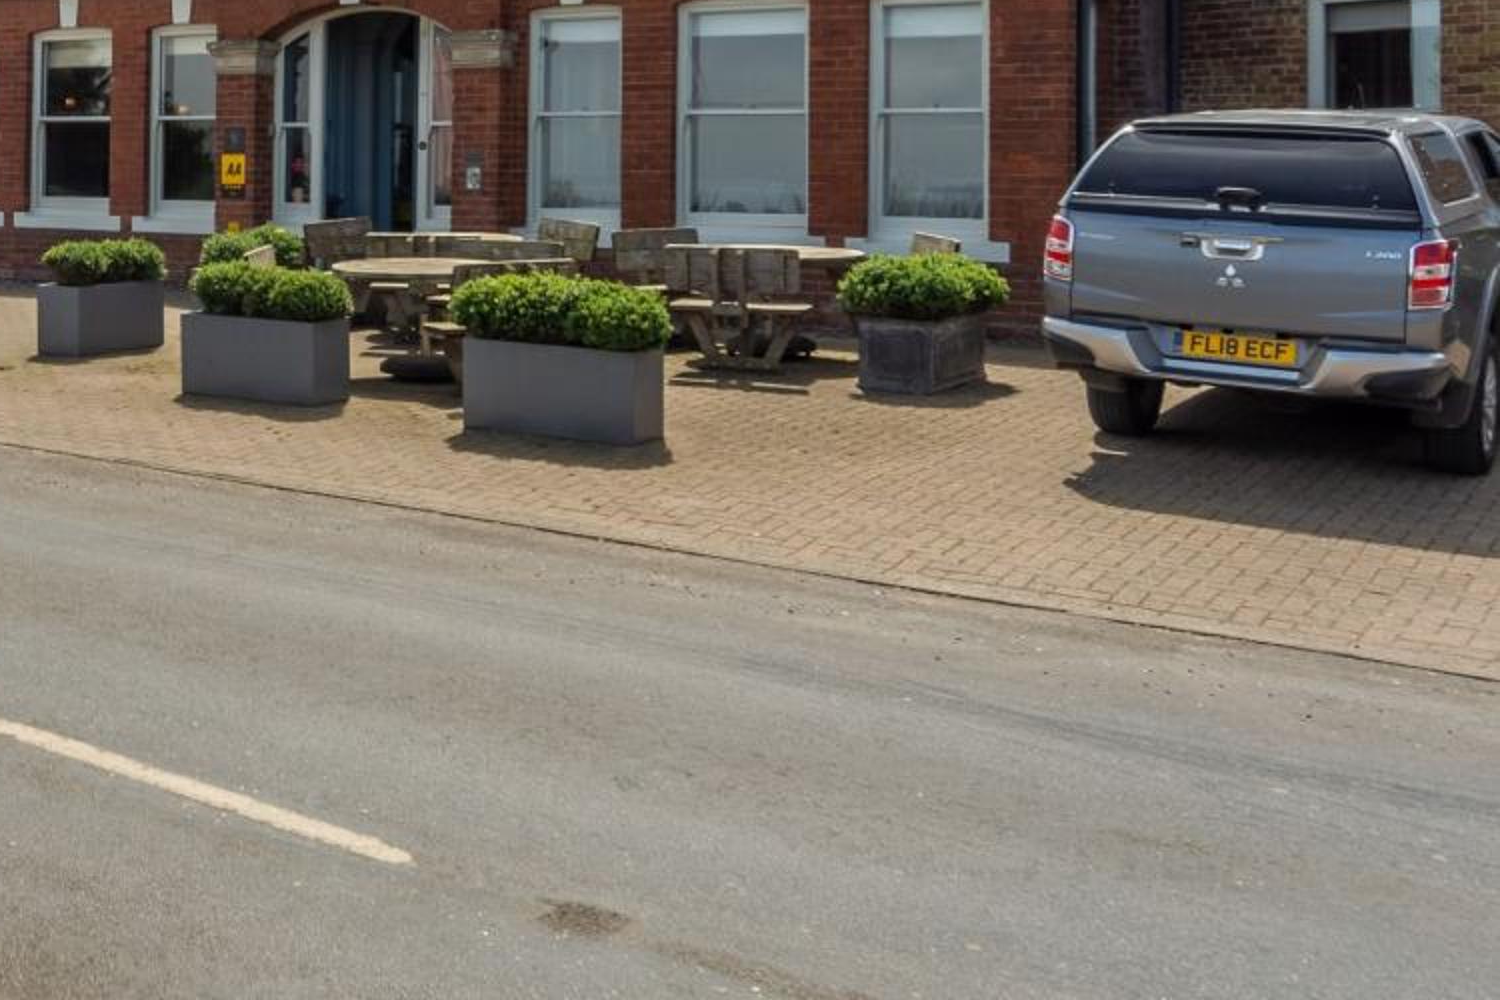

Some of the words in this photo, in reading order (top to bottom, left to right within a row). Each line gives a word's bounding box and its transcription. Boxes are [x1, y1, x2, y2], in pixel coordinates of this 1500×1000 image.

[227, 162, 242, 176] AA
[1189, 334, 1239, 356] FL18
[1244, 339, 1291, 361] ECF
